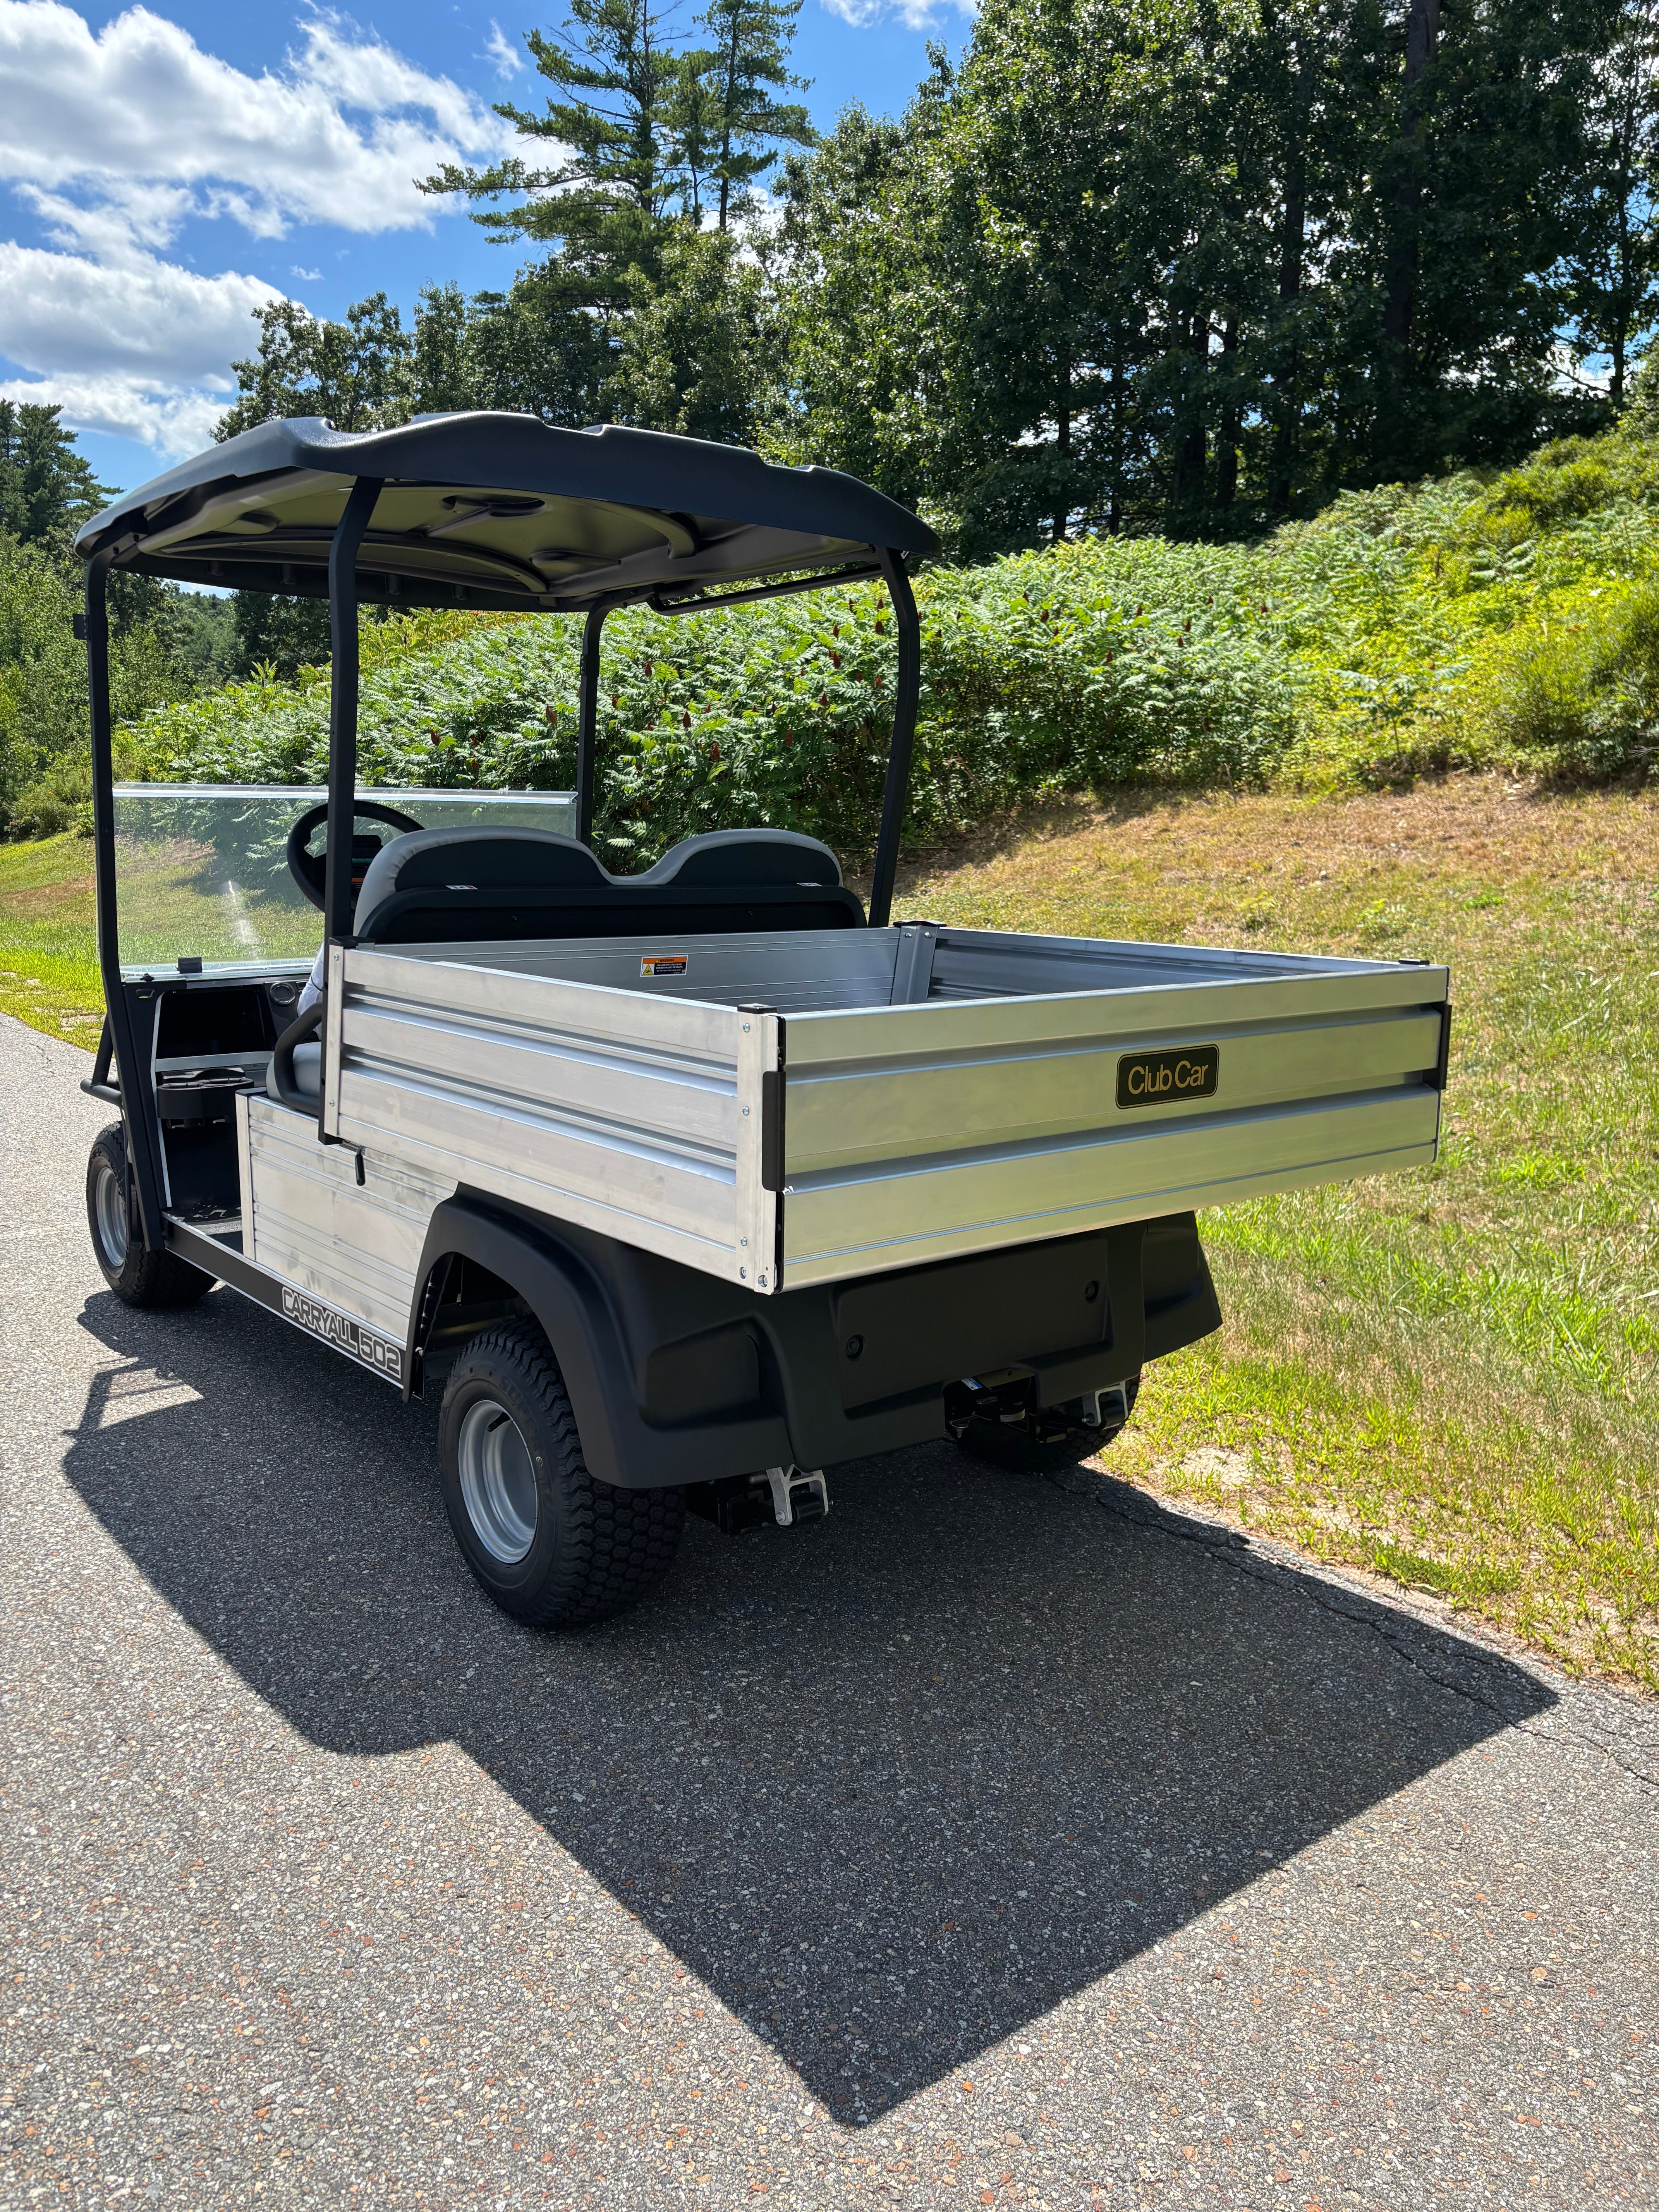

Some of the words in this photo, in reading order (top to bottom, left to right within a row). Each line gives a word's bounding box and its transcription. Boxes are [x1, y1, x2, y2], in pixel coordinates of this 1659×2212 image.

[1128, 1064, 1172, 1094] Club
[1175, 1060, 1208, 1088] Car
[282, 1286, 358, 1354] CARRYALL
[359, 1328, 401, 1379] 502
